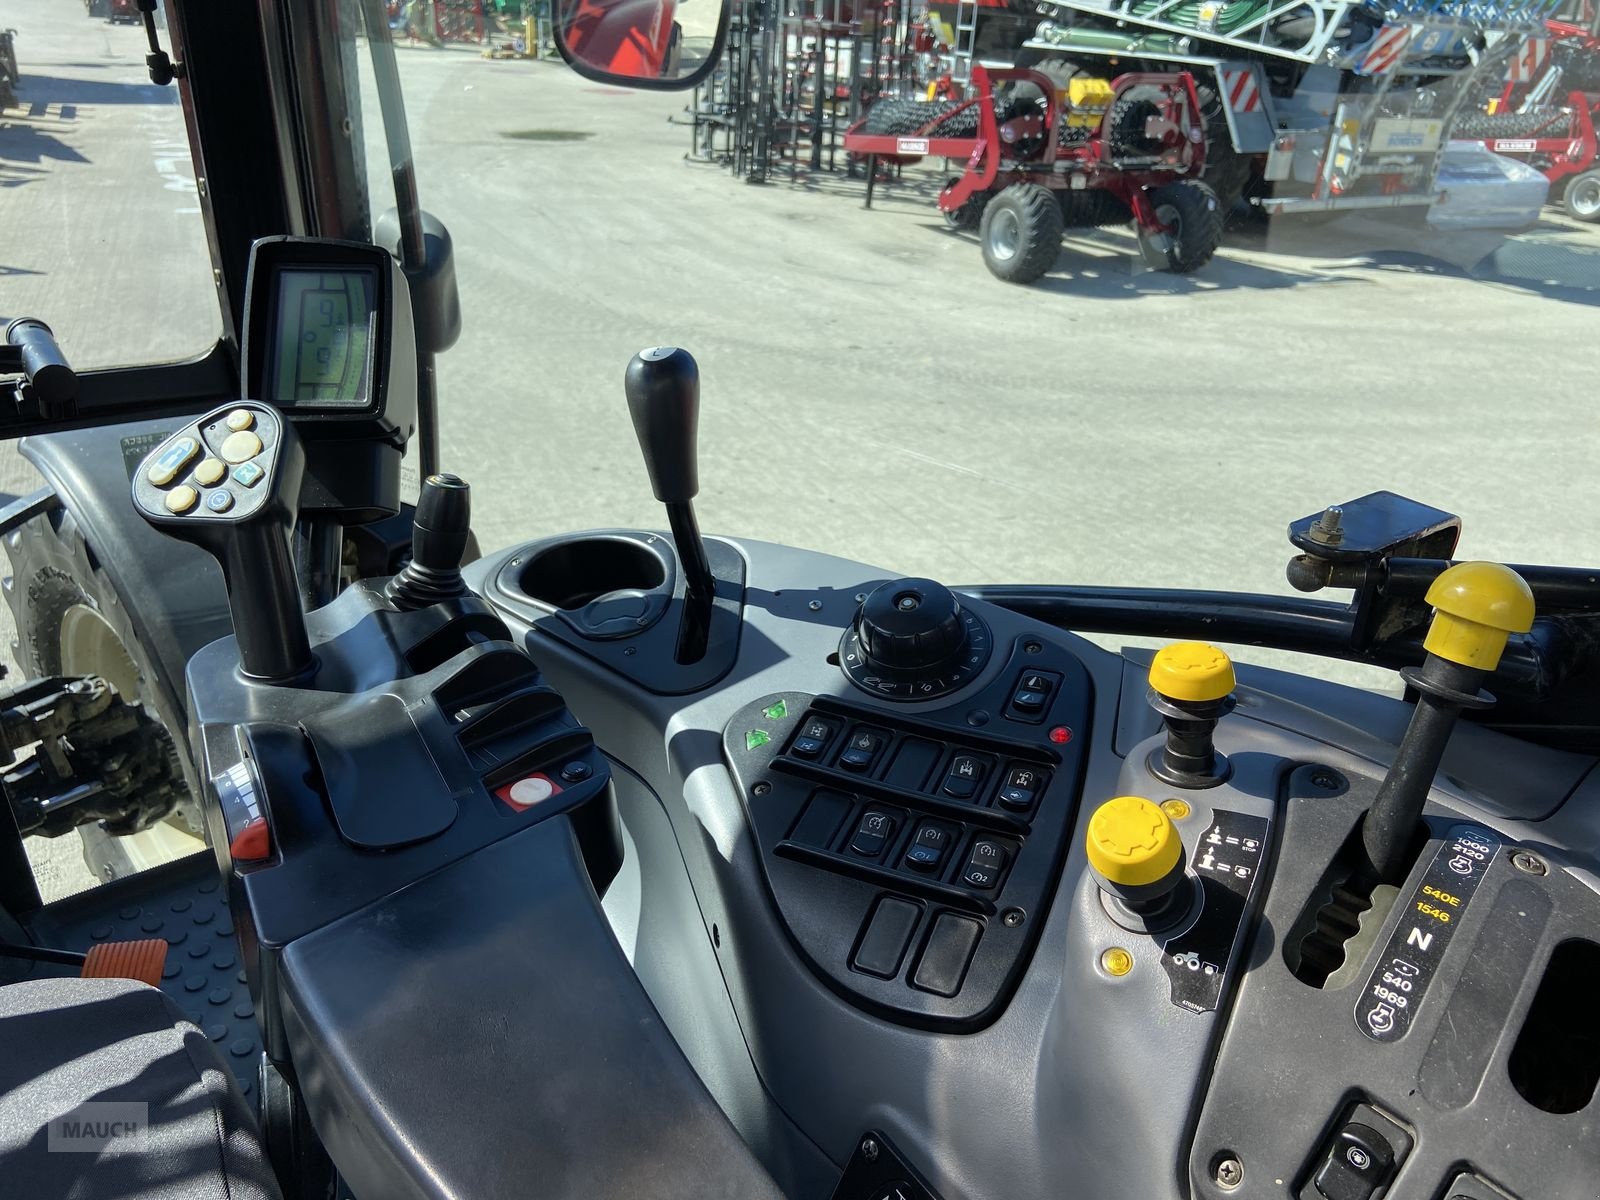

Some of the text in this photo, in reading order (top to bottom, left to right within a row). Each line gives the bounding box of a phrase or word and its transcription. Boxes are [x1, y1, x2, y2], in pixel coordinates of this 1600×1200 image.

[920, 683, 932, 692] 10
[1452, 843, 1485, 861] 2120
[1457, 837, 1490, 853] 1000
[1422, 885, 1461, 907] 540E
[1416, 901, 1450, 922] 1546
[1406, 926, 1433, 951] N
[1382, 971, 1412, 992] 540
[1373, 983, 1408, 1008] 1969
